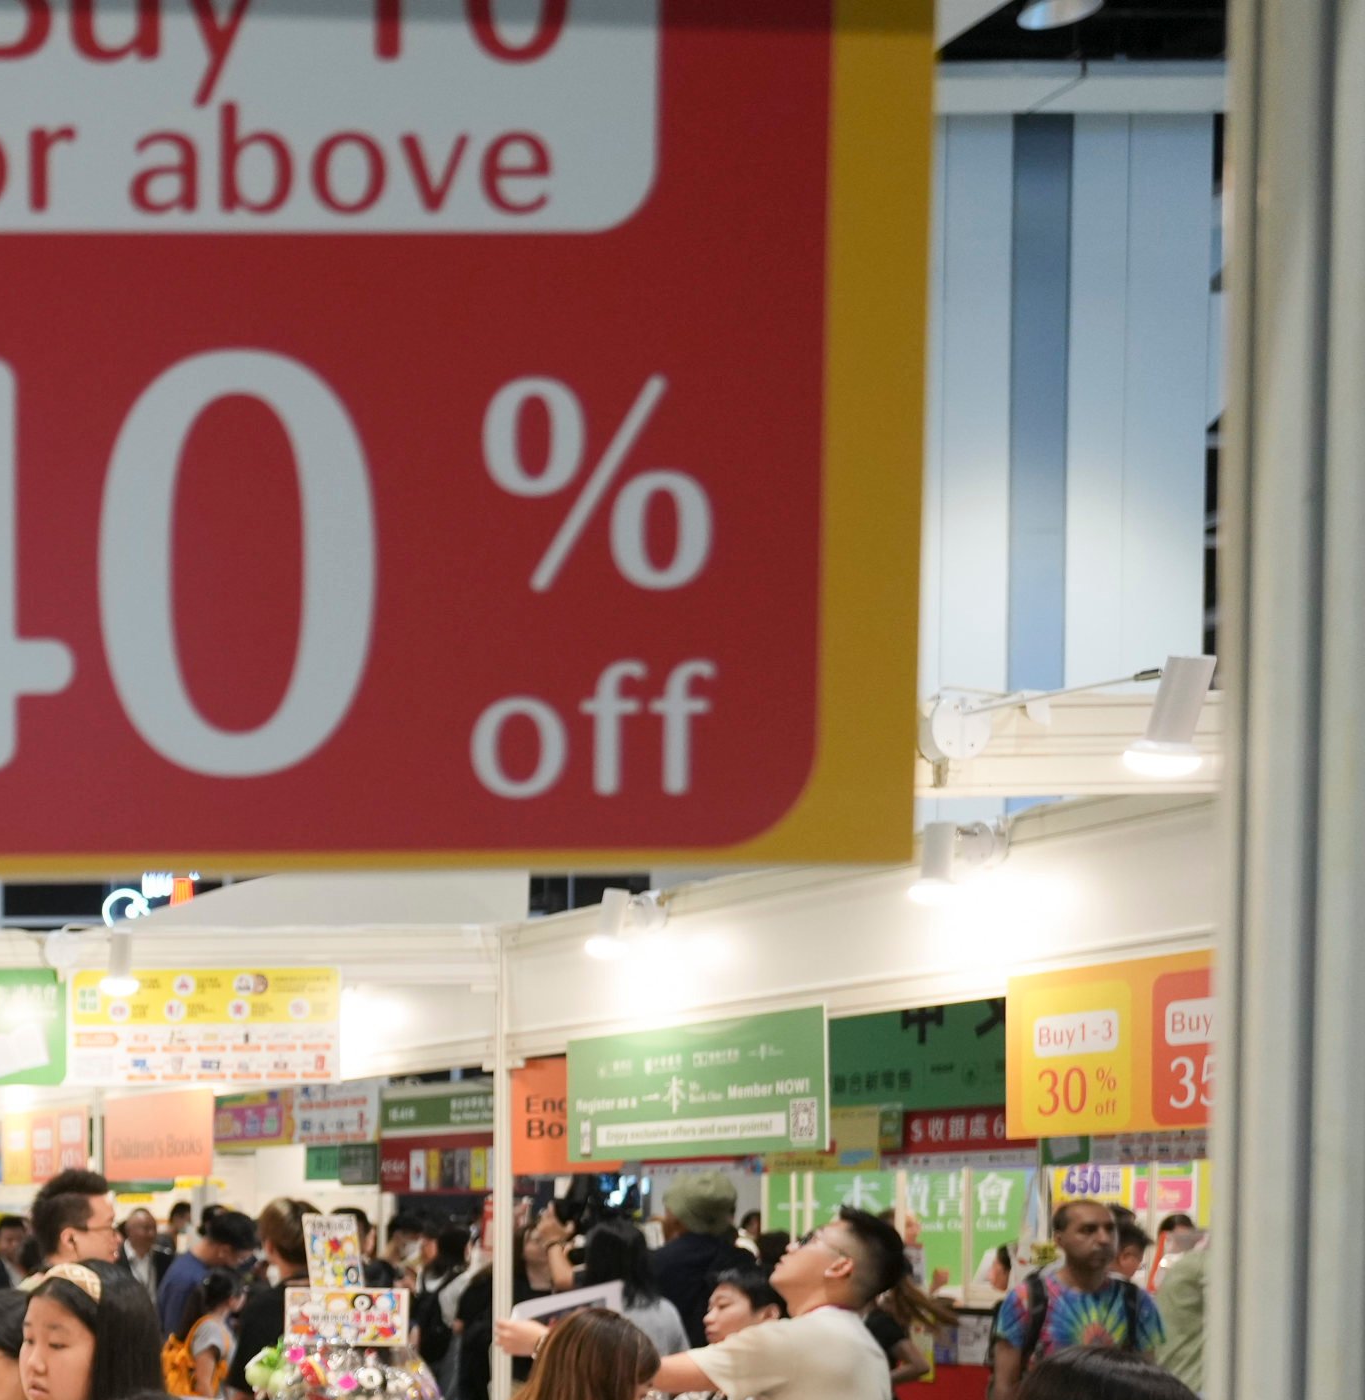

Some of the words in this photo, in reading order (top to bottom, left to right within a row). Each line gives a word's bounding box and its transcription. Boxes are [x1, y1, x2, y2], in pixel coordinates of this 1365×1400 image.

[126, 102, 553, 216] above
[468, 658, 717, 800] off
[727, 1084, 772, 1100] Member
[776, 1078, 810, 1094] NOW!
[1095, 1102, 1117, 1116] off
[606, 1129, 626, 1143] Enjoy
[629, 1125, 667, 1140] exclusive
[670, 1123, 696, 1137] offers
[168, 1135, 203, 1156] Books
